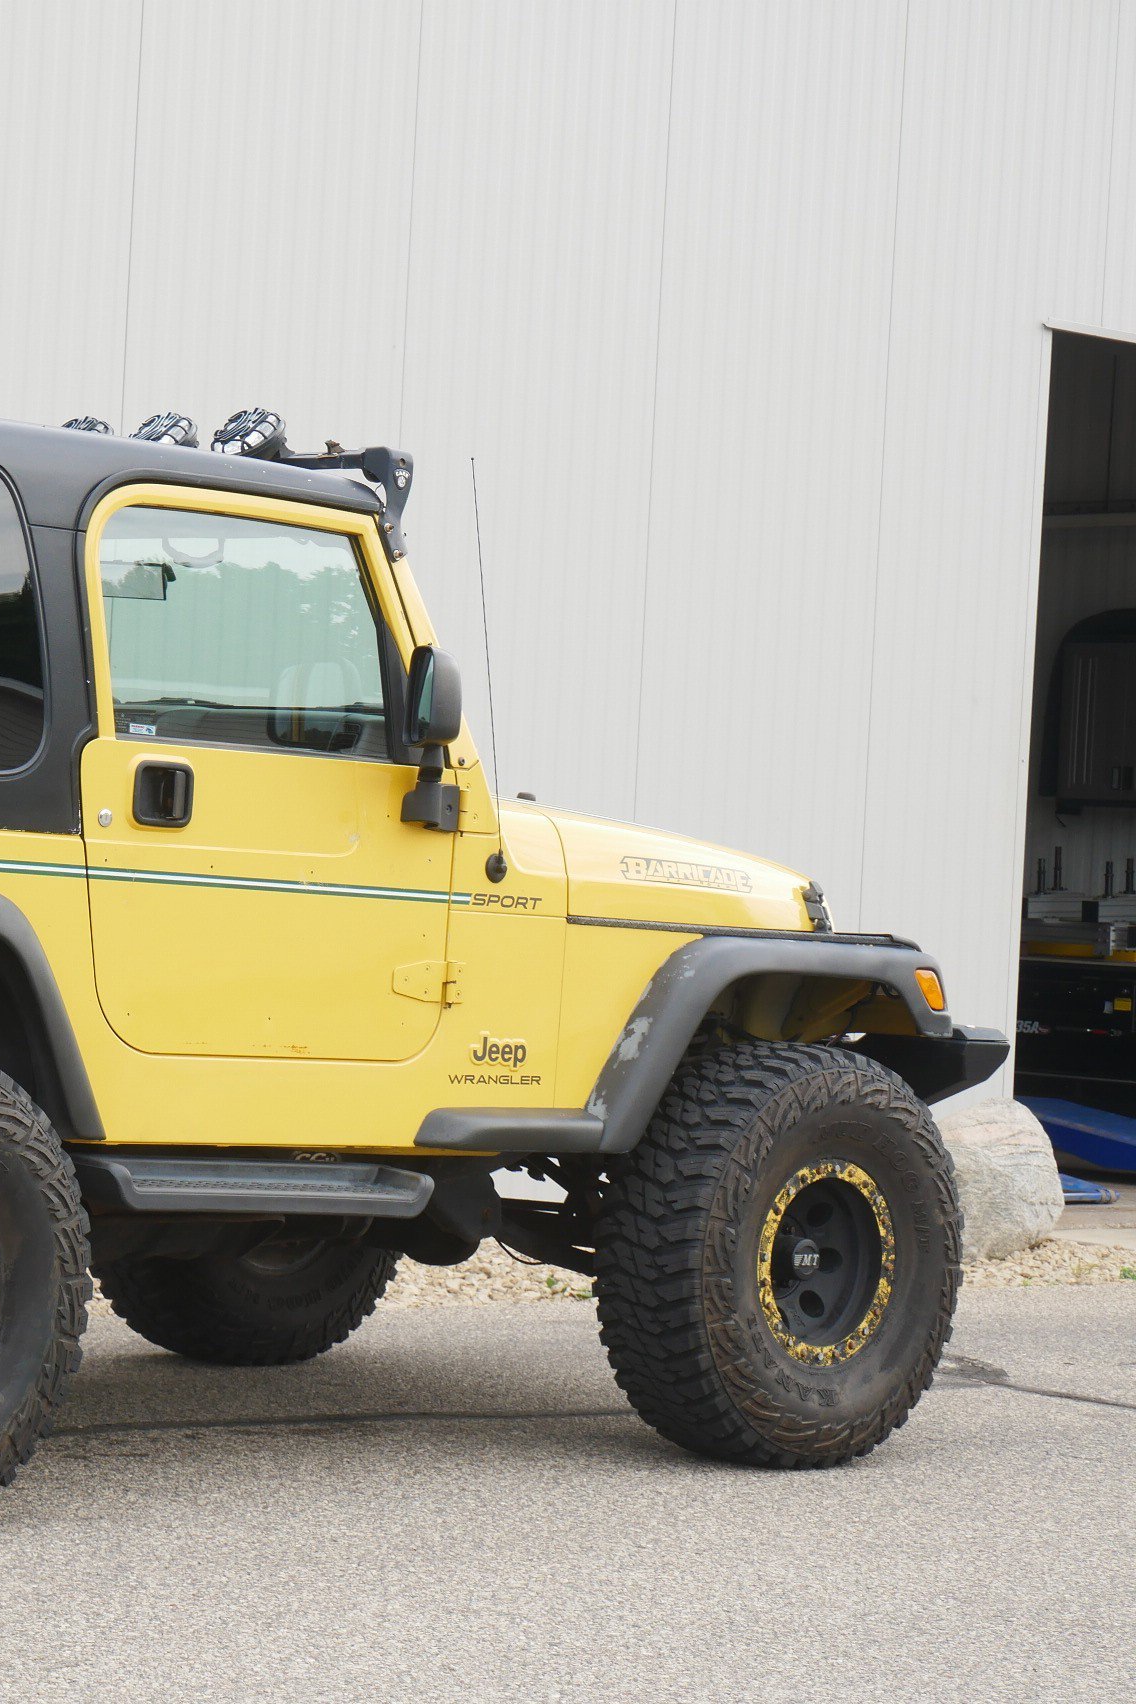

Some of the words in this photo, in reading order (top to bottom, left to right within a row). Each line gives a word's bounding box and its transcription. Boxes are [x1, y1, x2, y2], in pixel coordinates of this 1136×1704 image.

[620, 856, 752, 893] BARRICADE
[472, 893, 542, 910] SPORT
[473, 1036, 526, 1068] Jeep
[448, 1074, 541, 1086] WRANGLER
